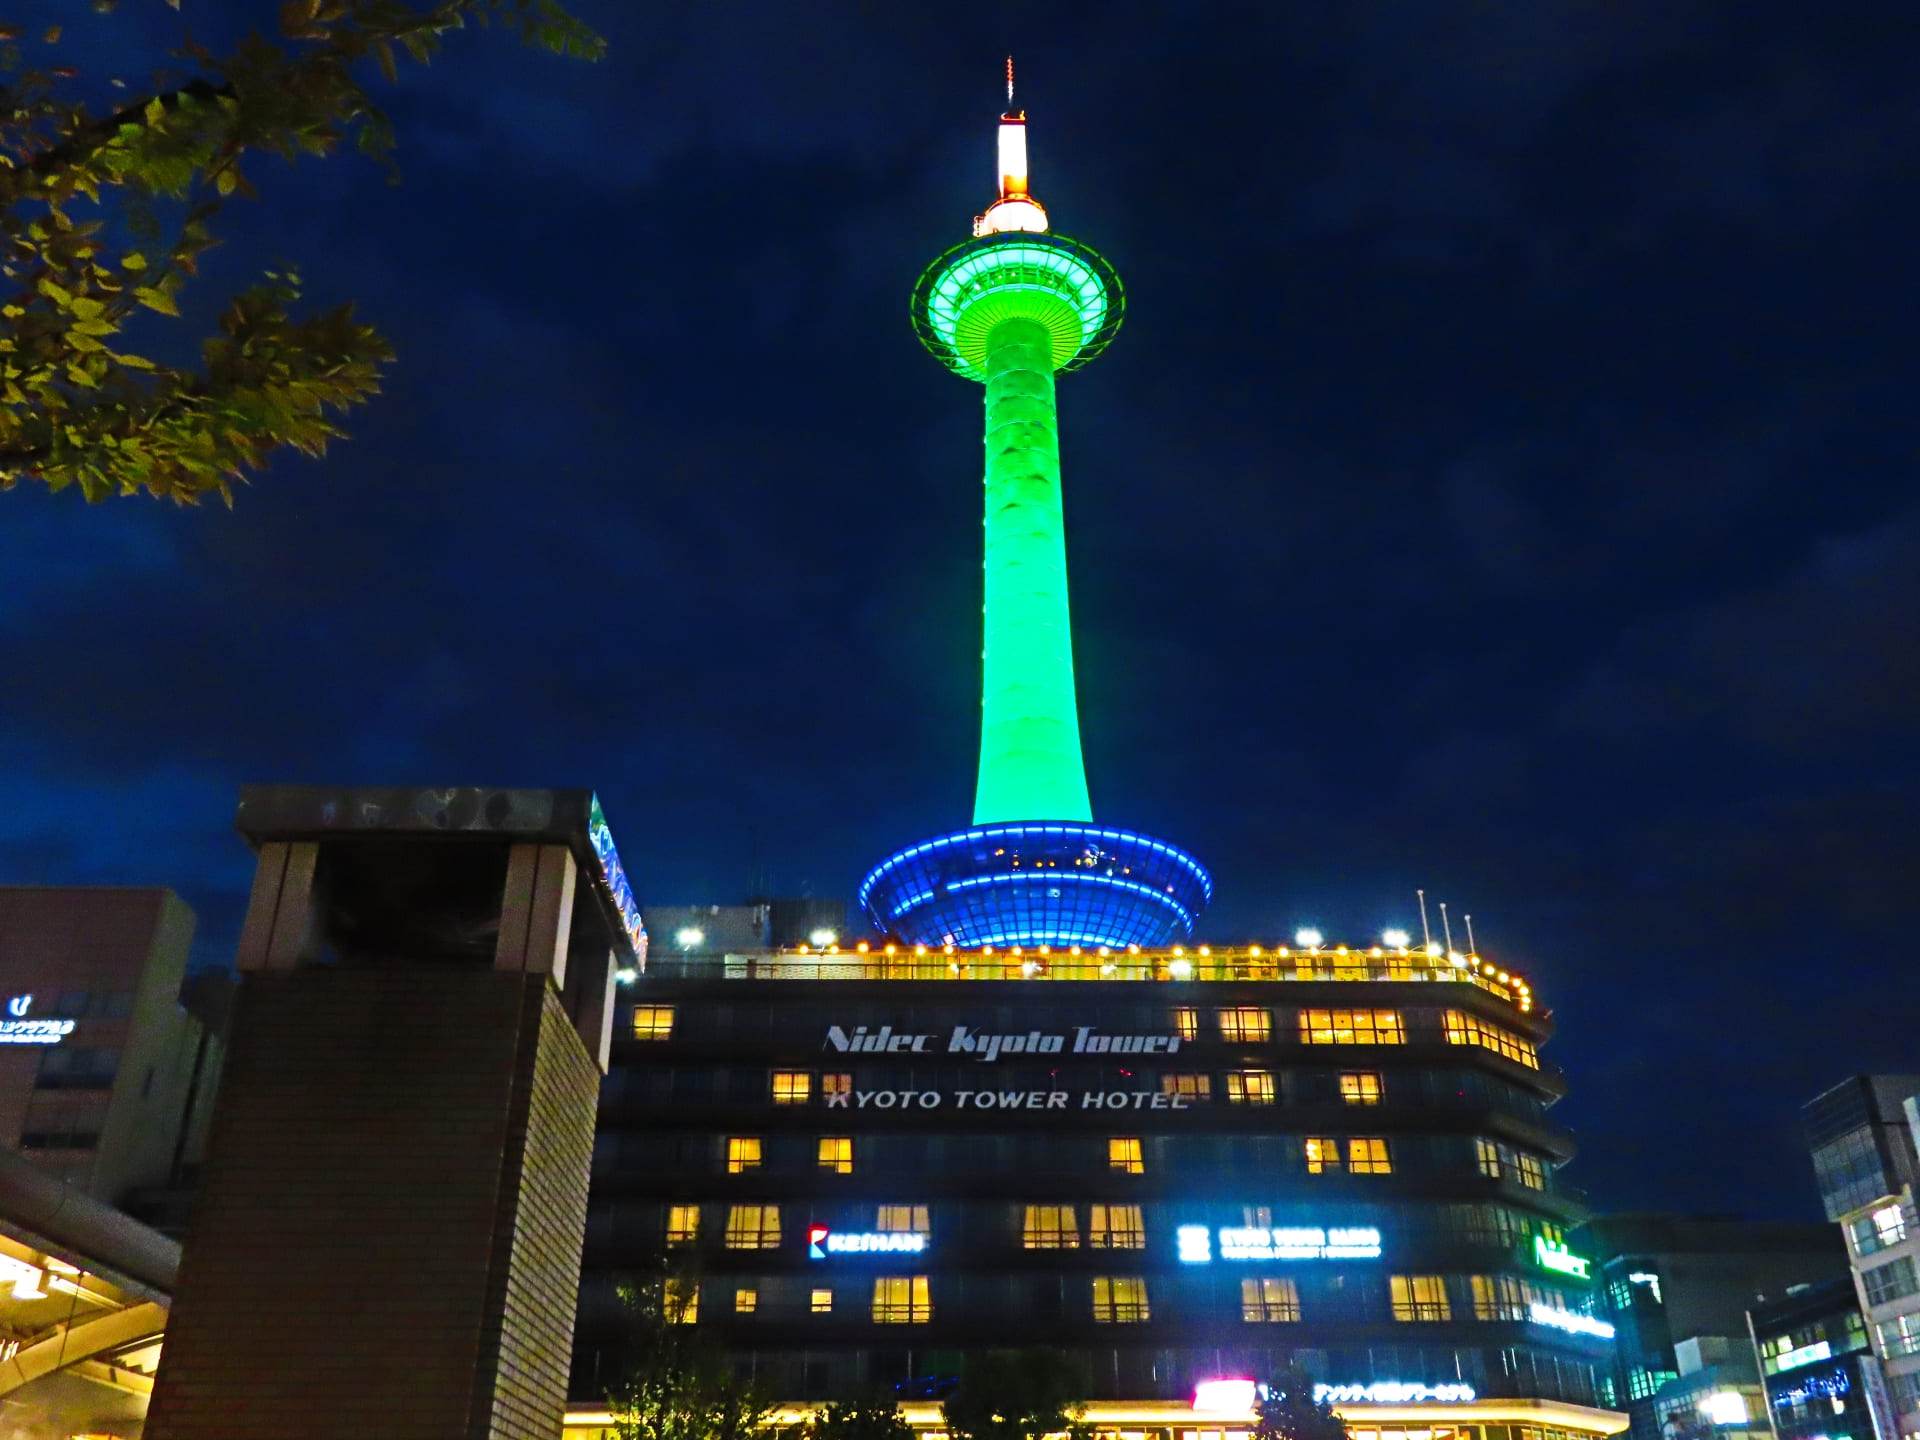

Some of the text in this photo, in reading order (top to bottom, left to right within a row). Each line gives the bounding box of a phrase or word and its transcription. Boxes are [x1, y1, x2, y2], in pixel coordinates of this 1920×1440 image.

[822, 1025, 1181, 1062] Nidec Kyoto Tower
[827, 1090, 1189, 1110] KYOTO TOWER HOTEL
[827, 1233, 924, 1252] KEIHAN
